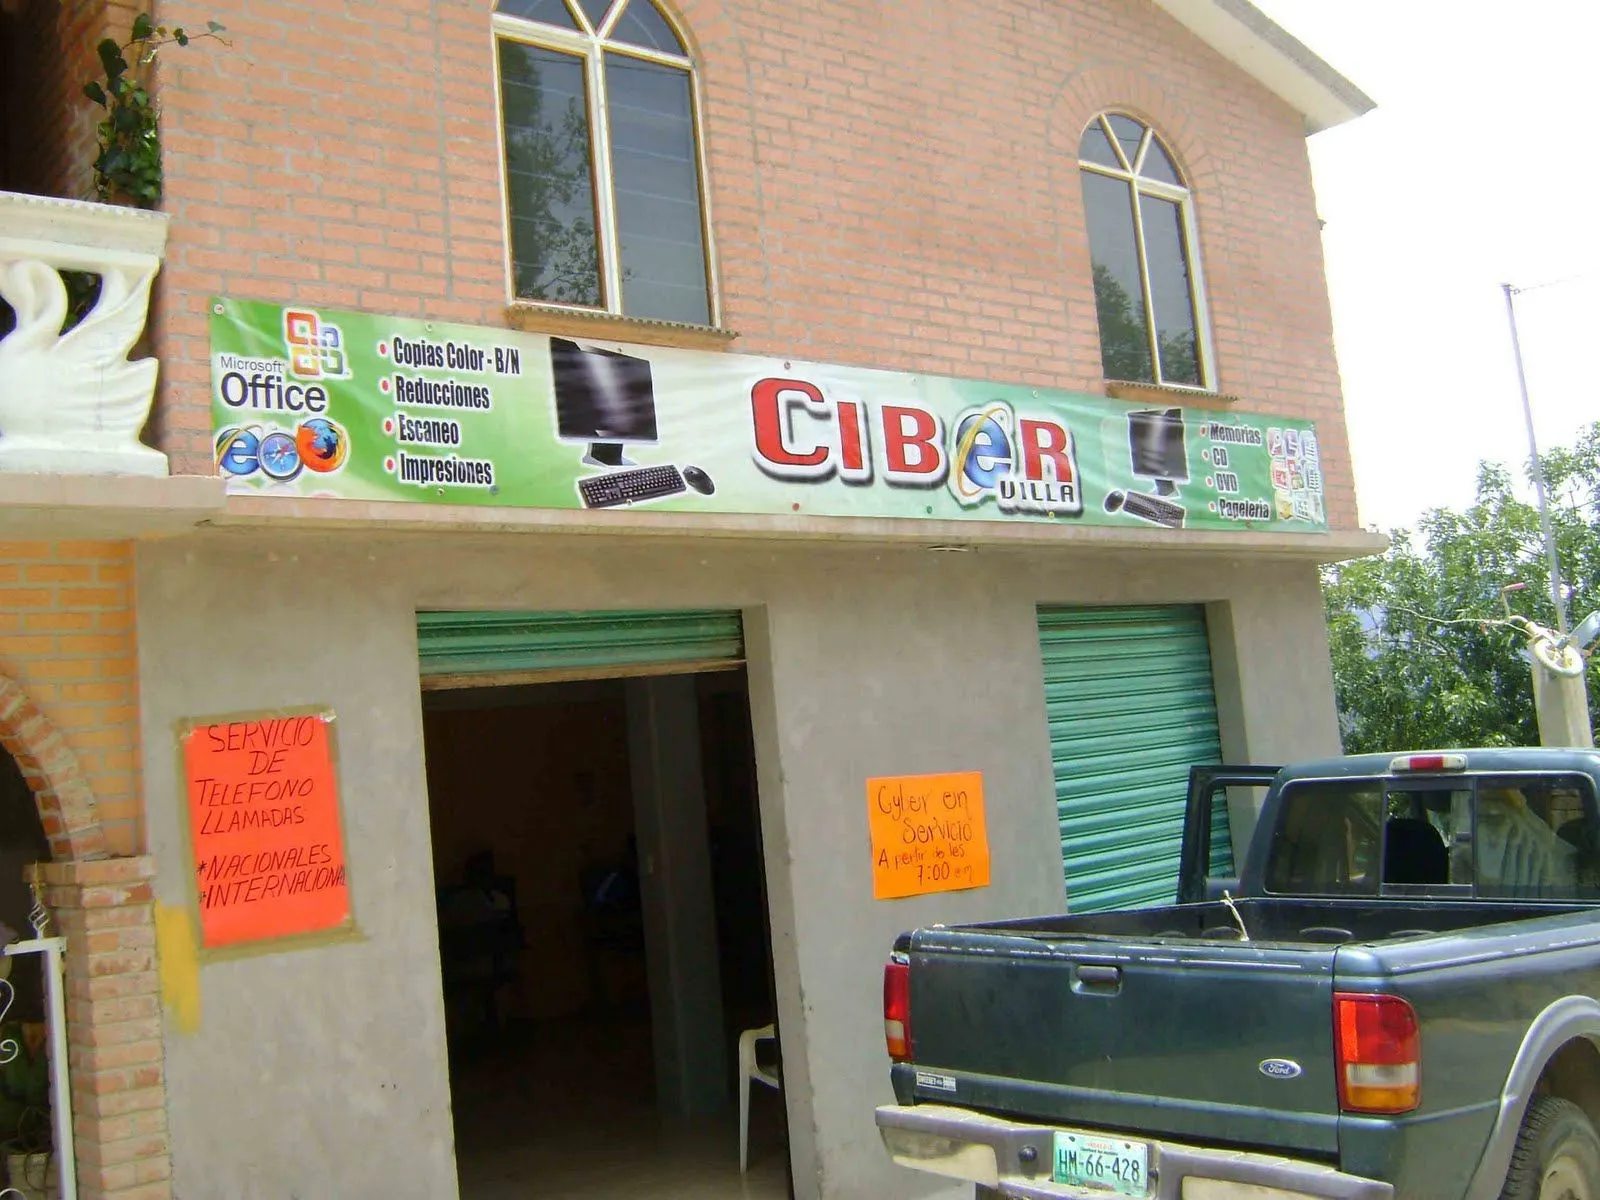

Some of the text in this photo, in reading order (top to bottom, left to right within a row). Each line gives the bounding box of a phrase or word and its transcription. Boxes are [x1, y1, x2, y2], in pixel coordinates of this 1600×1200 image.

[220, 355, 283, 373] Microsoft
[393, 336, 443, 368] Copias
[447, 342, 485, 372] Color
[495, 347, 520, 374] B/N
[221, 371, 326, 412] Office
[395, 375, 490, 409] Reducciones
[399, 414, 459, 444] Escaneo
[1210, 423, 1261, 445] Memorias
[400, 453, 492, 485] Impresiones
[1213, 448, 1228, 466] CD
[1216, 473, 1238, 491] DVD
[207, 716, 315, 752] SERVICIO
[248, 749, 288, 775] DE
[195, 778, 314, 806] TELEFONO
[200, 806, 305, 835] LLAMADAS
[903, 817, 972, 843] Servicio
[918, 861, 950, 886] 7:00
[1058, 1149, 1140, 1183] HM-66-428
